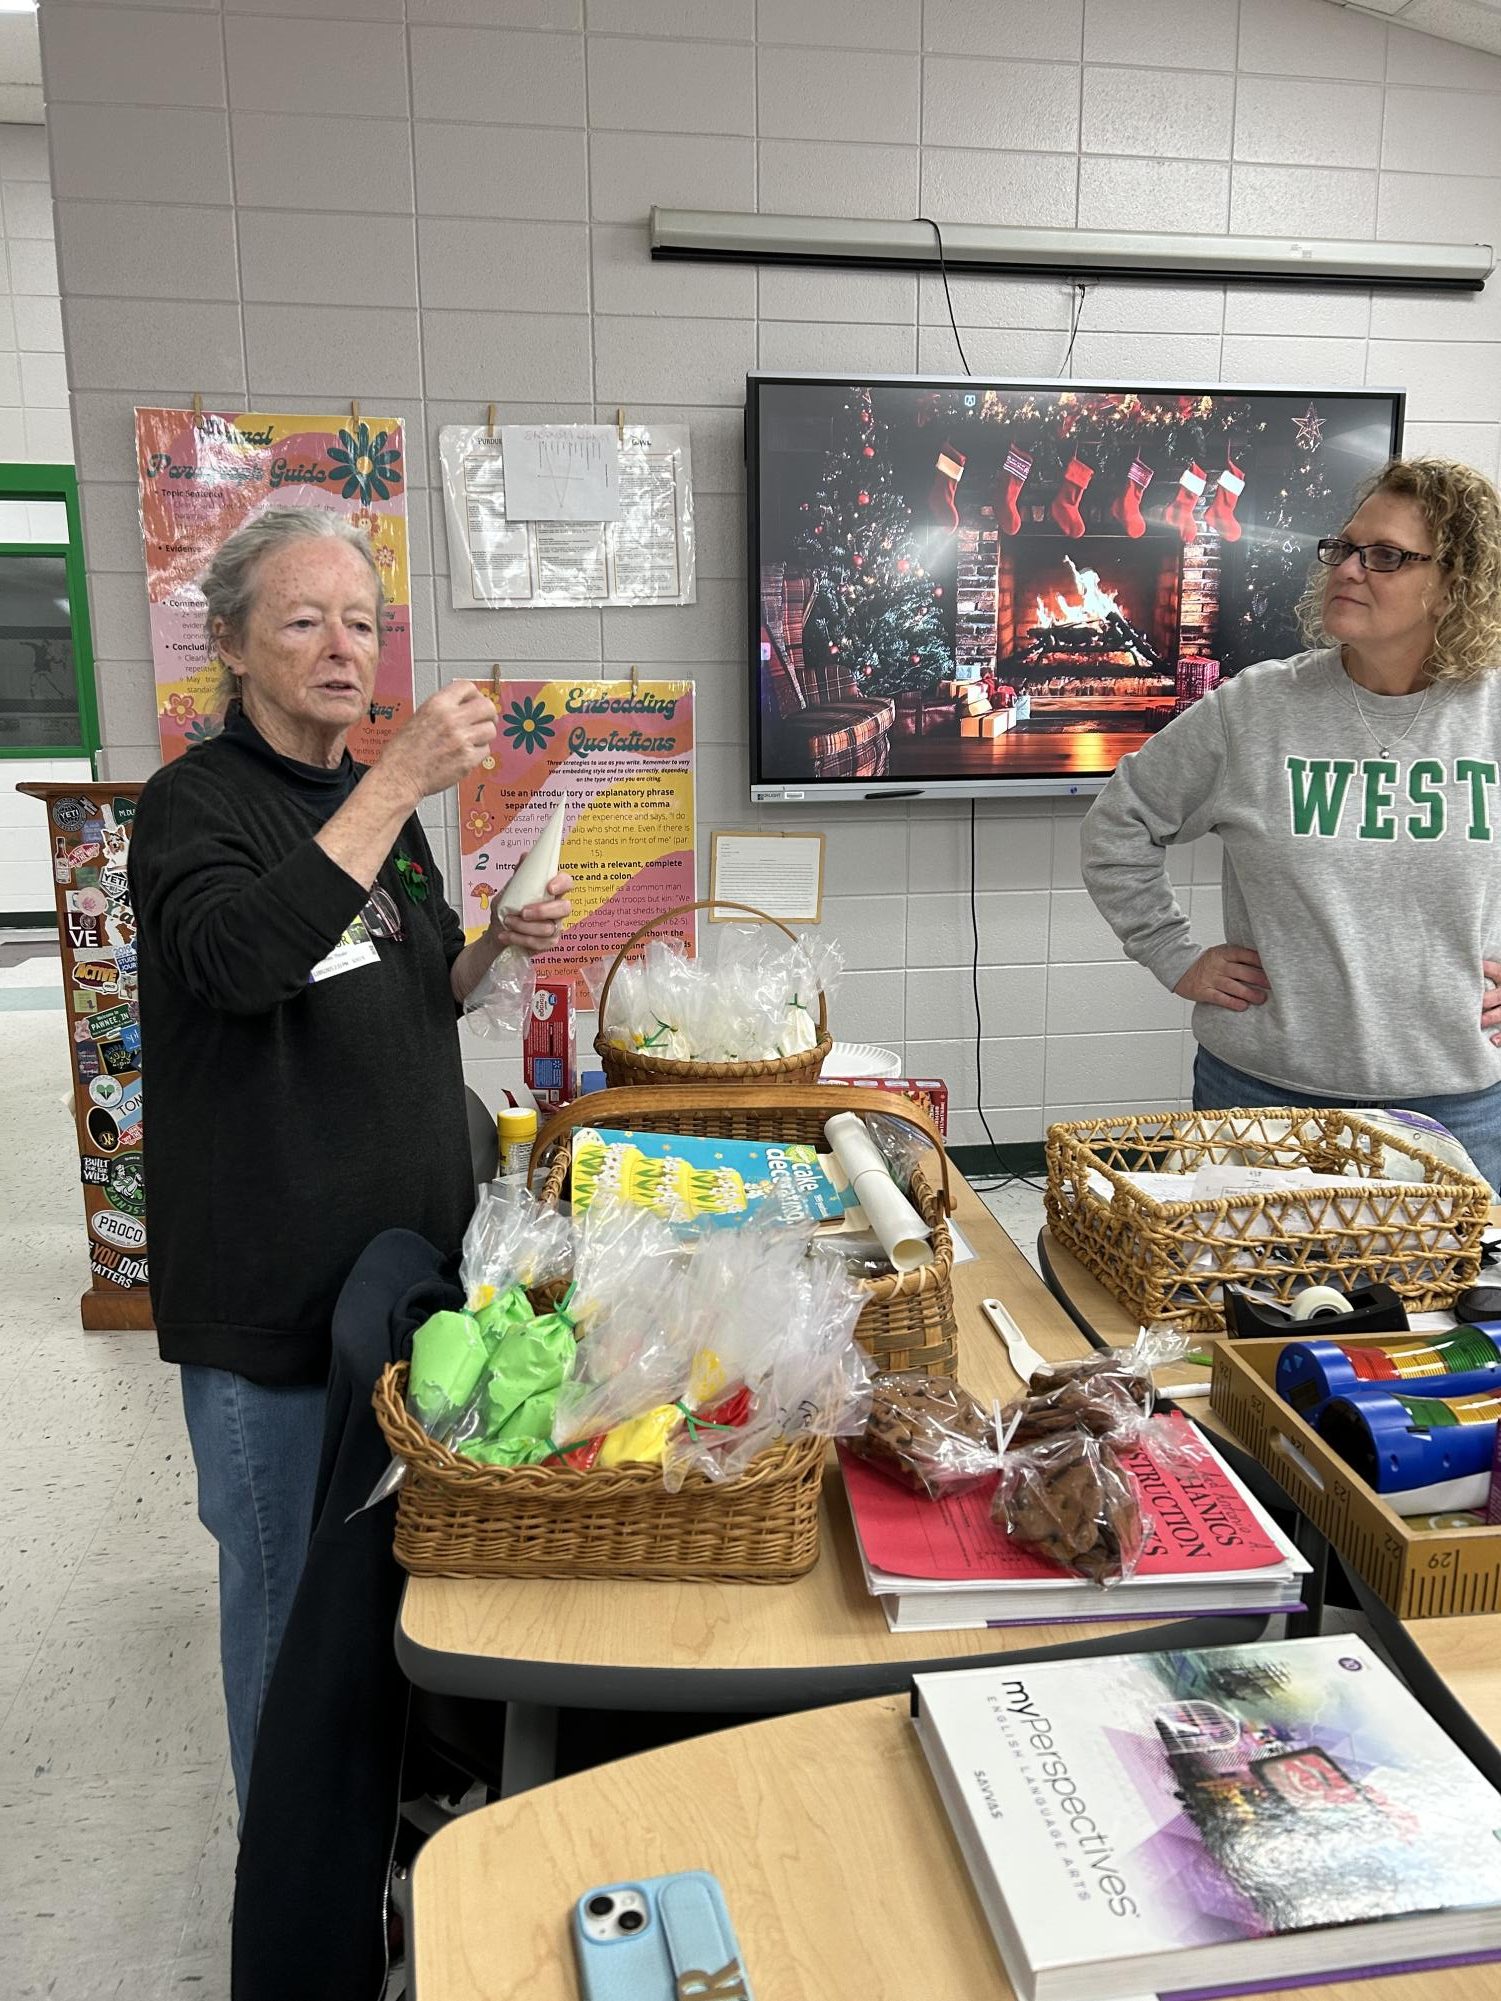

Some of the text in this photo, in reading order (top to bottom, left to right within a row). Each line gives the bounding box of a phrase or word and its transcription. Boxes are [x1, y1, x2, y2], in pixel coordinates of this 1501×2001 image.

[269, 457, 327, 487] Guide
[161, 489, 183, 498] Topic
[565, 687, 678, 720] Embedding
[568, 726, 676, 757] Quotations
[596, 789, 645, 798] explanatory
[646, 789, 674, 798] phrase
[1284, 755, 1500, 844] WEST
[60, 809, 79, 819] YETI
[505, 802, 547, 811] separated
[587, 802, 611, 810] quote
[592, 813, 632, 822] experience
[475, 853, 490, 870] 2
[580, 861, 598, 869] with
[607, 861, 643, 869] relevant,
[645, 860, 682, 868] complete
[104, 874, 127, 887] YETI
[588, 884, 614, 892] himself
[584, 897, 601, 905] just
[622, 895, 646, 904] troops
[594, 908, 615, 917] today
[75, 963, 118, 983] ACTIVE
[121, 963, 137, 971] JOUR
[554, 968, 578, 976] before
[120, 1012, 130, 1021] IN
[84, 1157, 111, 1168] BUILT
[791, 1162, 823, 1193] cake
[97, 1215, 143, 1243] PROCO
[94, 1242, 141, 1279] YOU DO
[90, 1262, 133, 1289] MATTERS
[1128, 1446, 1212, 1558] STRUCTION
[1428, 1551, 1452, 1570] 29
[974, 1769, 1004, 1820] SAVVAS
[987, 1696, 1091, 1902] ENGLISH LANGUAGE ARTS
[1002, 1681, 1137, 1918] myPerspectives
